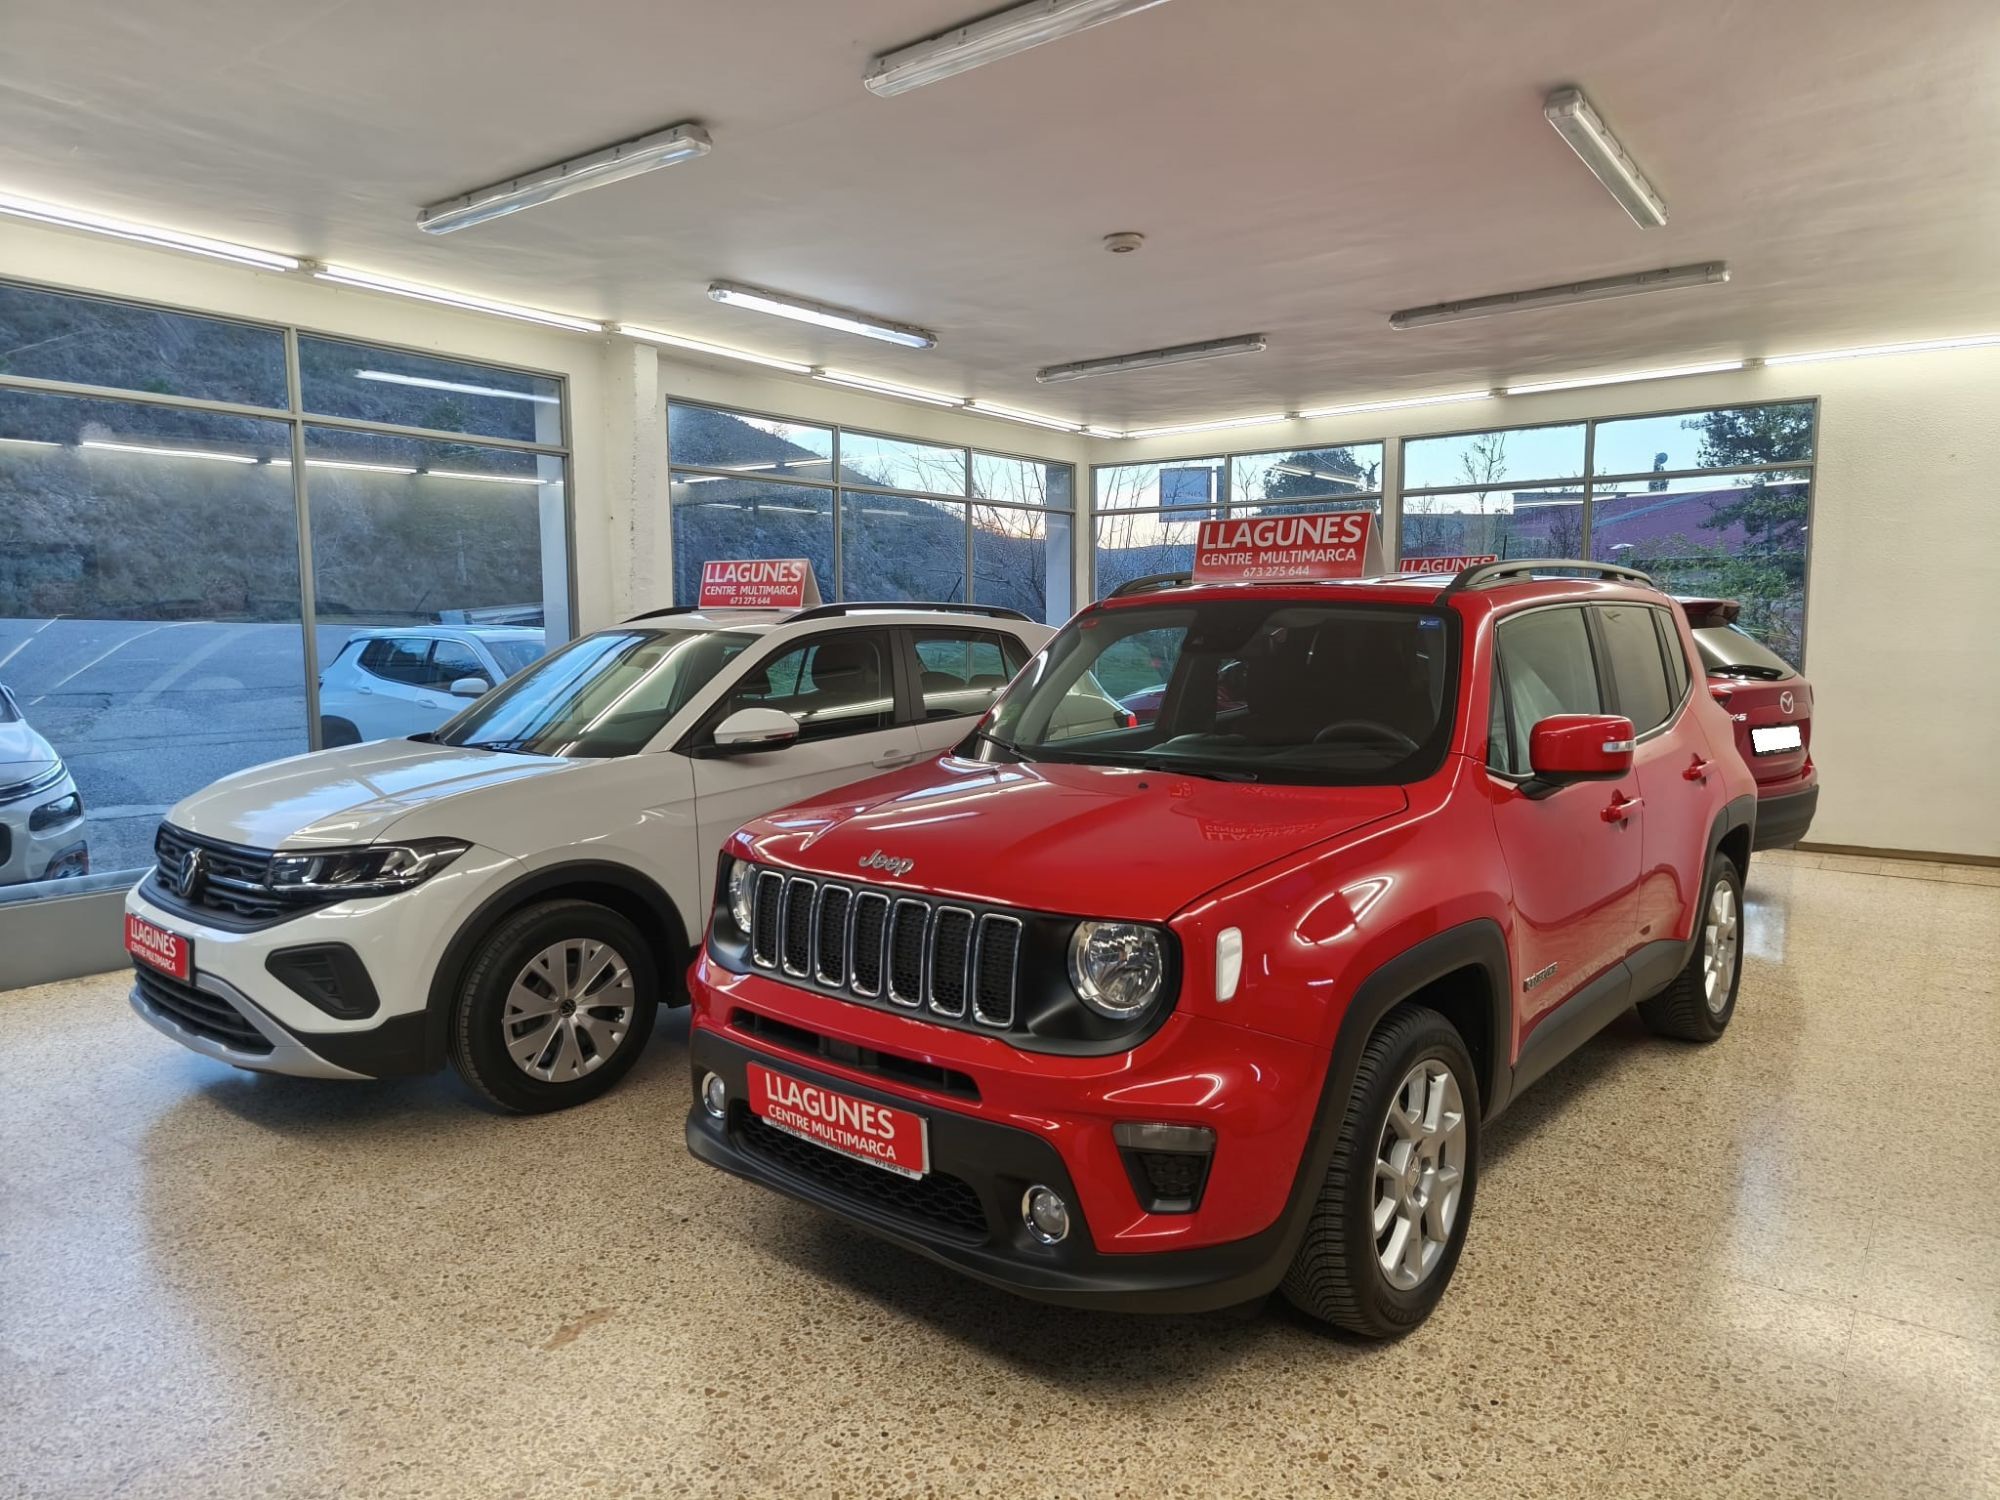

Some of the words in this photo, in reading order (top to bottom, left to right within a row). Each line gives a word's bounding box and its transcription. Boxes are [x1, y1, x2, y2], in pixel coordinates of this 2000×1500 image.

[1202, 515, 1363, 550] LLAGUNES
[1202, 551, 1253, 566] CENTRE
[1259, 547, 1357, 564] MULTIMARCA
[705, 562, 802, 583] LLAGUNES
[1243, 567, 1263, 577] 673
[1266, 566, 1286, 577] 275
[1288, 565, 1310, 576] 644
[705, 585, 737, 595] CENTRE
[740, 585, 798, 595] MULTIMARCA
[859, 849, 914, 877] Jeep
[131, 918, 177, 958] LLAGUNES
[765, 1072, 895, 1140] LLAGUNES
[768, 1104, 810, 1131] CENTRE
[811, 1120, 897, 1160] MULTIMARCA
